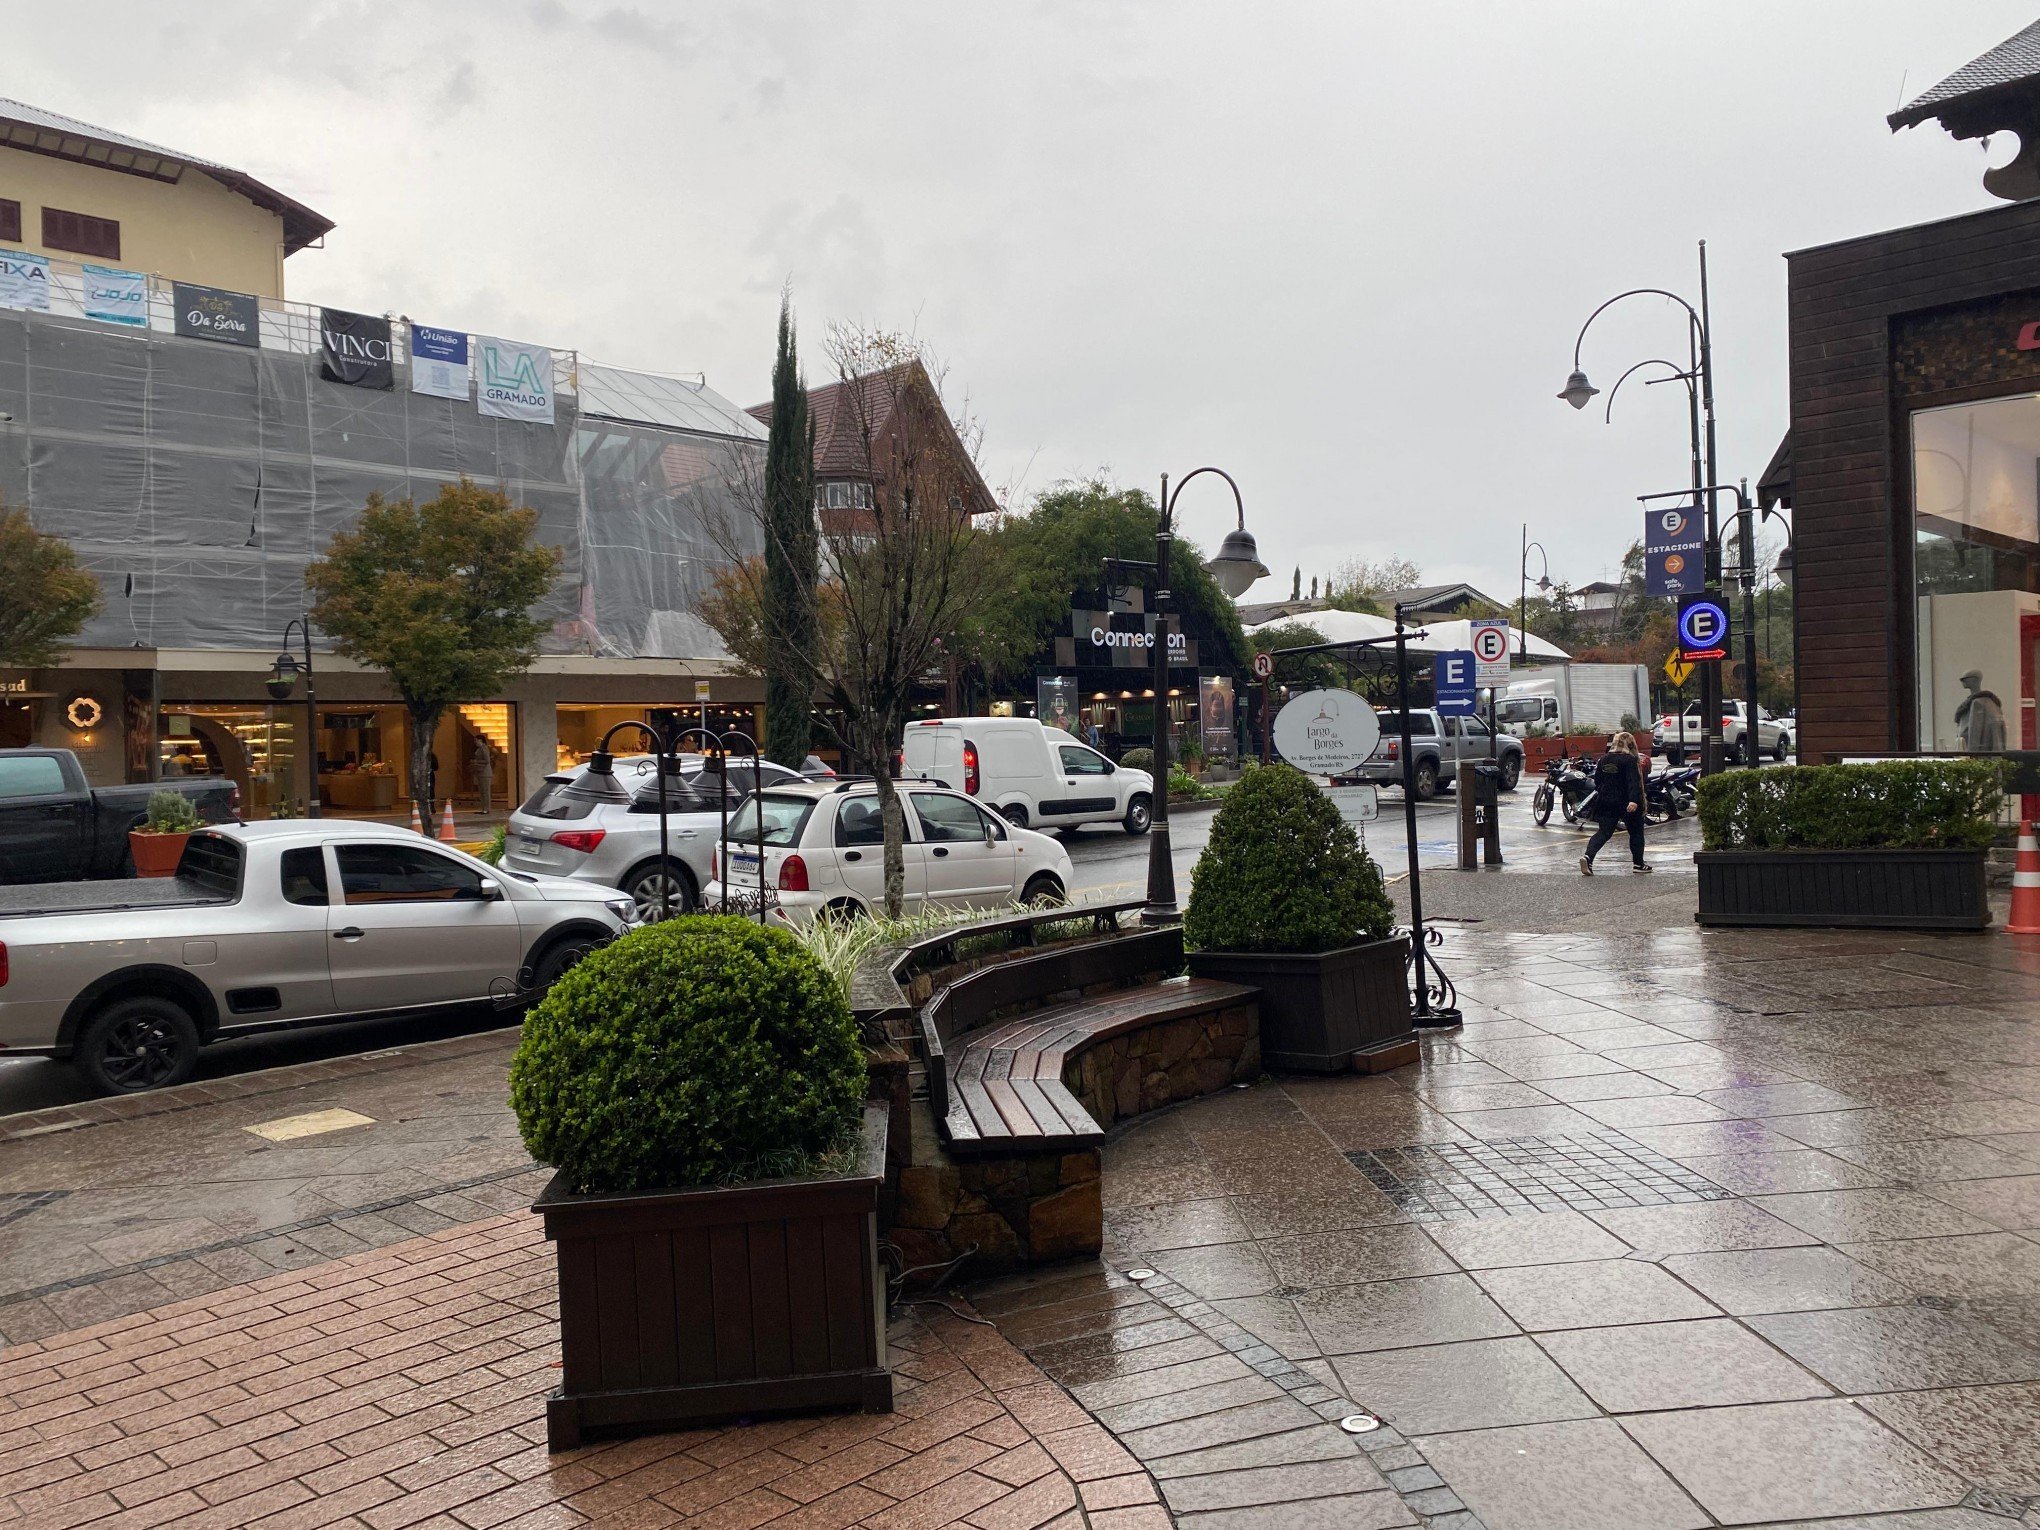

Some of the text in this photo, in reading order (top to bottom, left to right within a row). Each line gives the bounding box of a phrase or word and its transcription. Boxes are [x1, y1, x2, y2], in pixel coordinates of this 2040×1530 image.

[0, 261, 46, 281] IXA
[187, 310, 247, 332] Da Serra
[324, 330, 392, 361] VINCI
[432, 333, 458, 345] União
[339, 354, 378, 367] Construtora
[485, 346, 545, 395] LA
[486, 388, 546, 407] GRAMADO
[1667, 515, 1676, 527] E
[1648, 542, 1701, 553] ESTACIONE
[1666, 582, 1682, 590] park
[1693, 612, 1713, 636] E
[1091, 627, 1186, 648] Connecon
[1485, 635, 1495, 654] E
[1447, 660, 1464, 683] E
[1307, 727, 1330, 739] Largo
[1314, 739, 1344, 750] Borges
[1300, 754, 1317, 762] Borges
